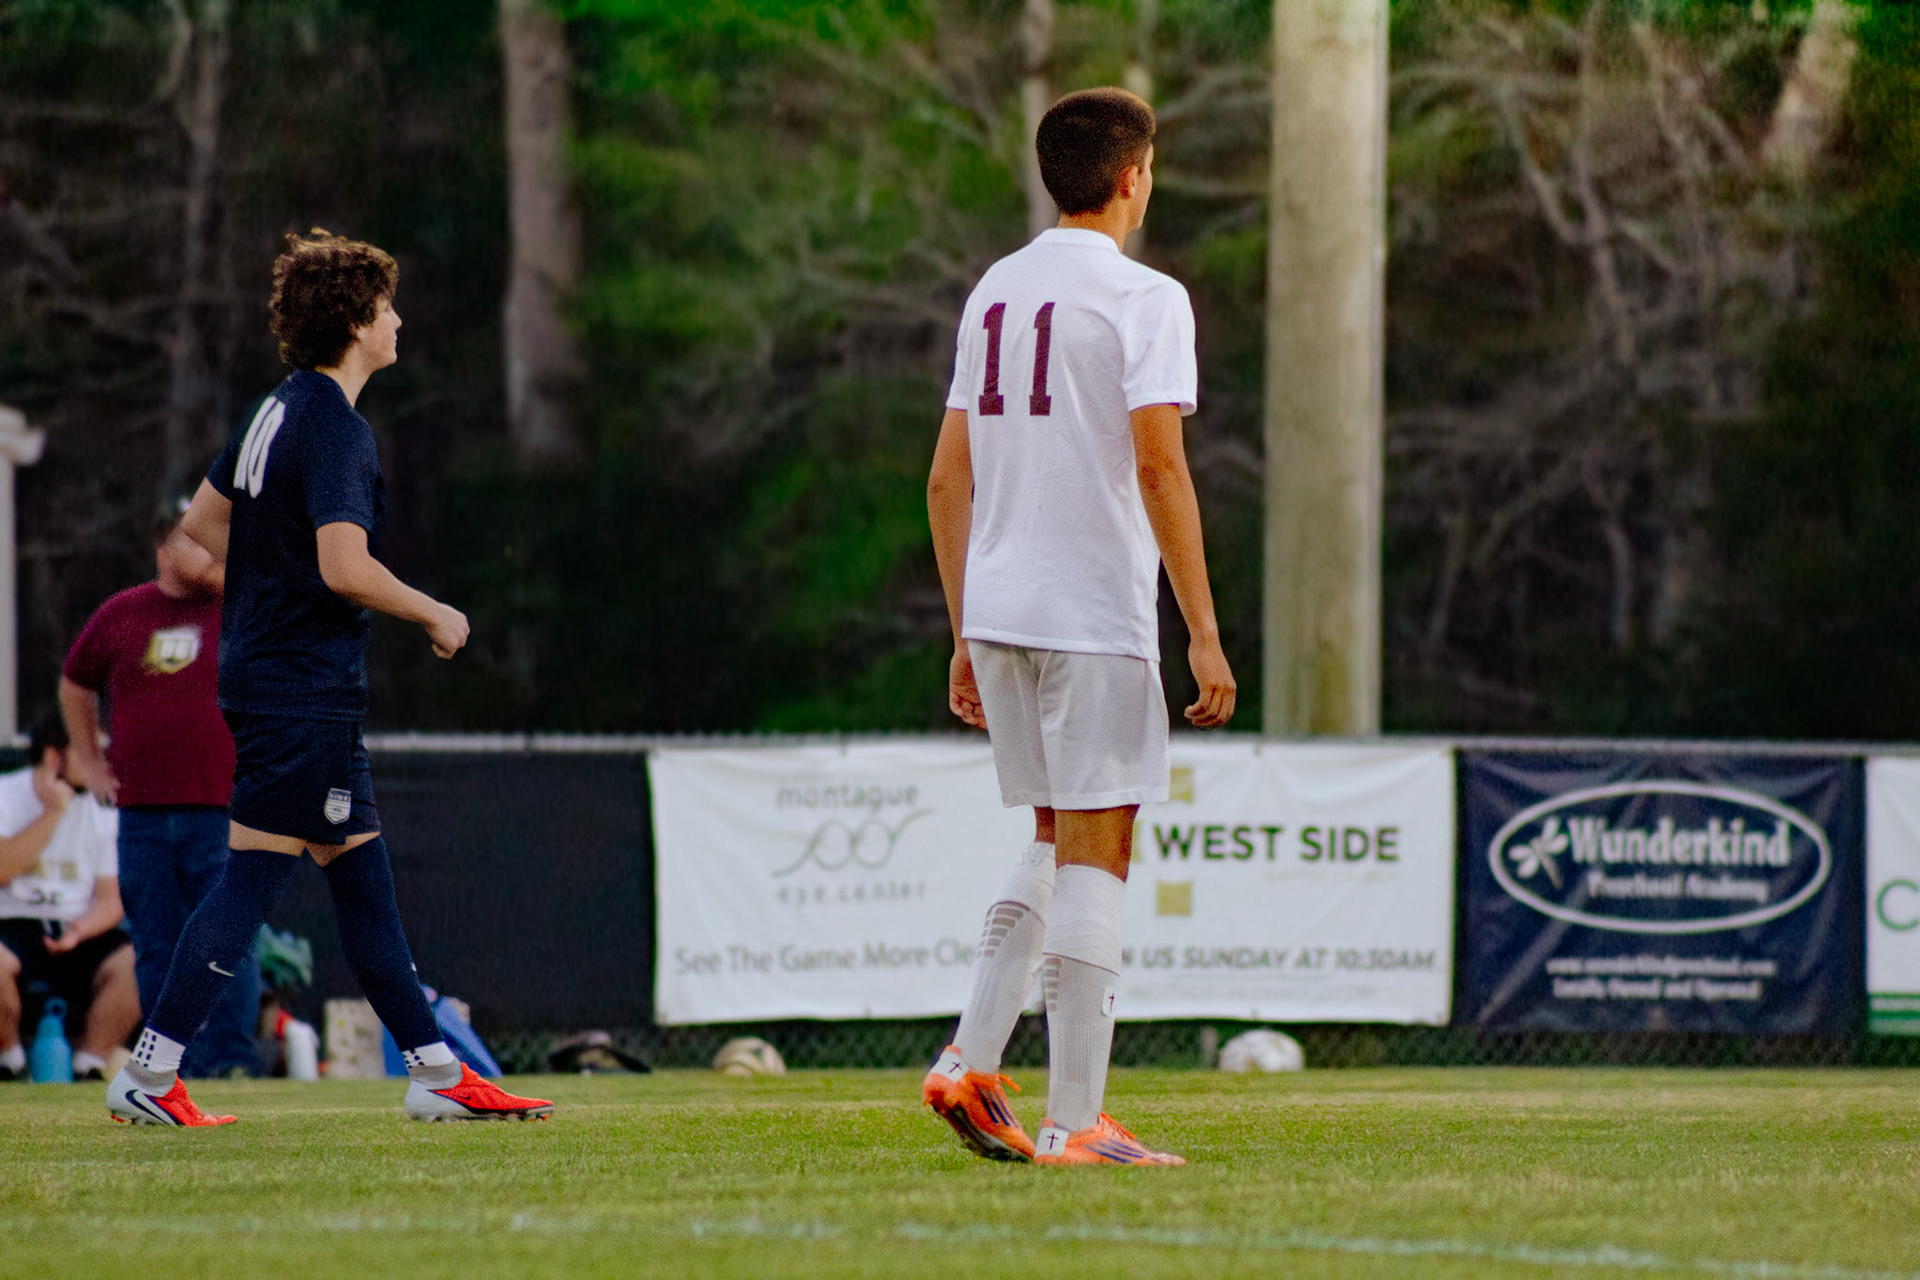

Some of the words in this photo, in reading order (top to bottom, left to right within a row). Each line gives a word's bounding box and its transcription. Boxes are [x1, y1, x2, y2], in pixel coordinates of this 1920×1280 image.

[978, 302, 1056, 416] 11
[233, 396, 286, 499] 10
[776, 784, 919, 813] montague
[1153, 825, 1283, 860] WEST
[1300, 826, 1400, 862] SIDE
[1568, 816, 1791, 867] Wunderkind
[777, 883, 823, 905] eye
[839, 881, 926, 901] center
[675, 946, 721, 975] See
[728, 945, 773, 972] The
[780, 943, 856, 971] Game
[863, 941, 928, 968] More
[934, 938, 975, 967] Cle
[1142, 946, 1175, 969] US
[1182, 947, 1289, 971] SUNDAY
[1294, 948, 1329, 970] AT
[1335, 948, 1436, 971] 10:30AM
